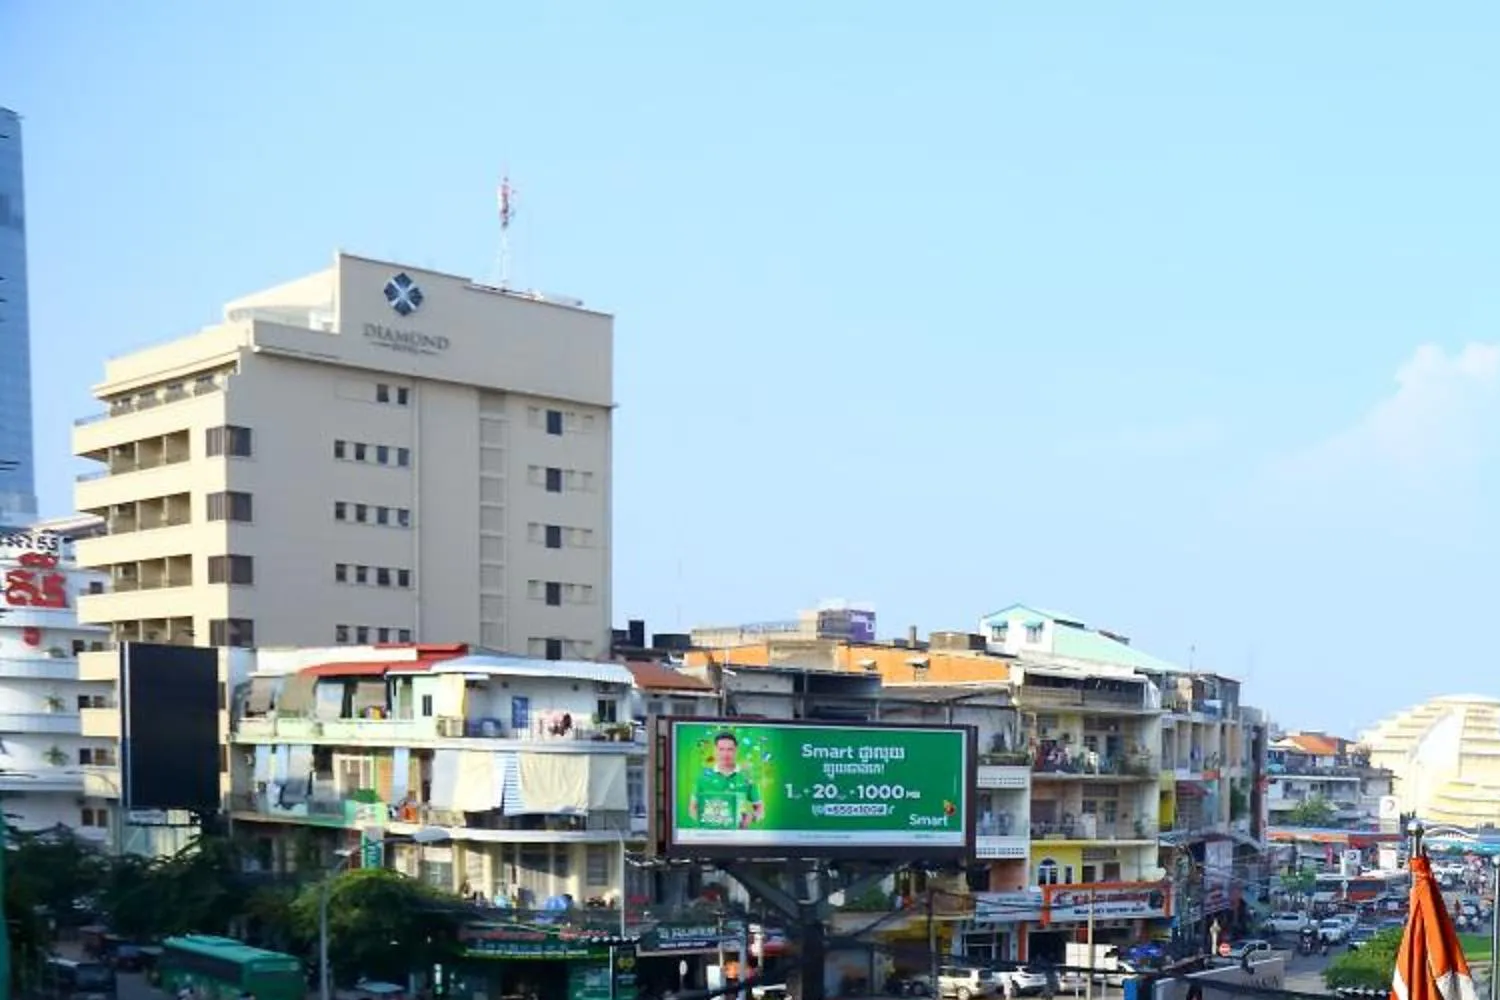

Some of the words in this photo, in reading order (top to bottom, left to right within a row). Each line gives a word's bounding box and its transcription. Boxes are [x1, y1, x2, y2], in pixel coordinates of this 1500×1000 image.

[362, 322, 450, 350] DIAMOND
[801, 743, 854, 759] Smart
[812, 783, 838, 799] 20
[857, 784, 905, 799] 1000
[909, 814, 949, 826] Smart
